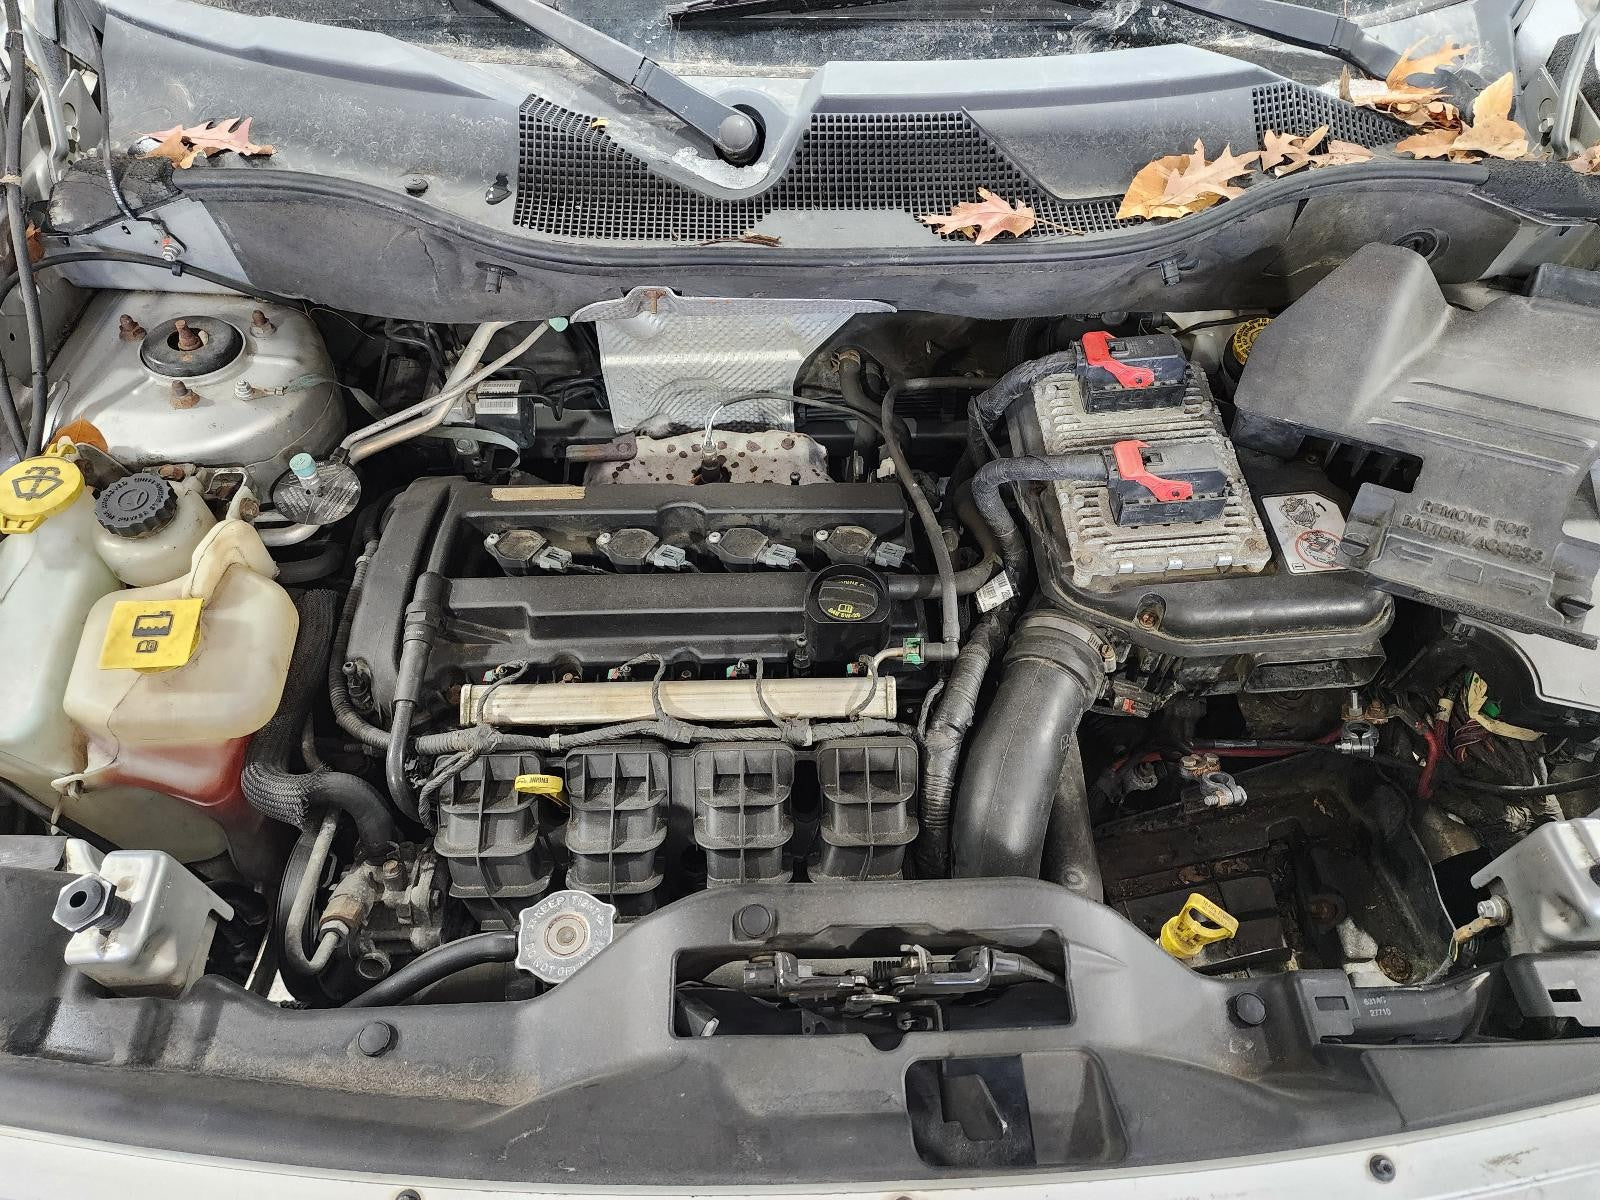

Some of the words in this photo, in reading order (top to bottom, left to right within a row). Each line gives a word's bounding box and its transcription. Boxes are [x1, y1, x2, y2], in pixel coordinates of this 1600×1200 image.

[1420, 499, 1490, 529] REMOVE
[1494, 518, 1531, 539] FOR
[1402, 514, 1472, 544] BATTERY
[1473, 536, 1544, 562] ACCESS
[533, 896, 567, 919] KEEP
[571, 895, 602, 916] TIGHT
[525, 942, 537, 959] DO
[533, 957, 557, 976] NOT
